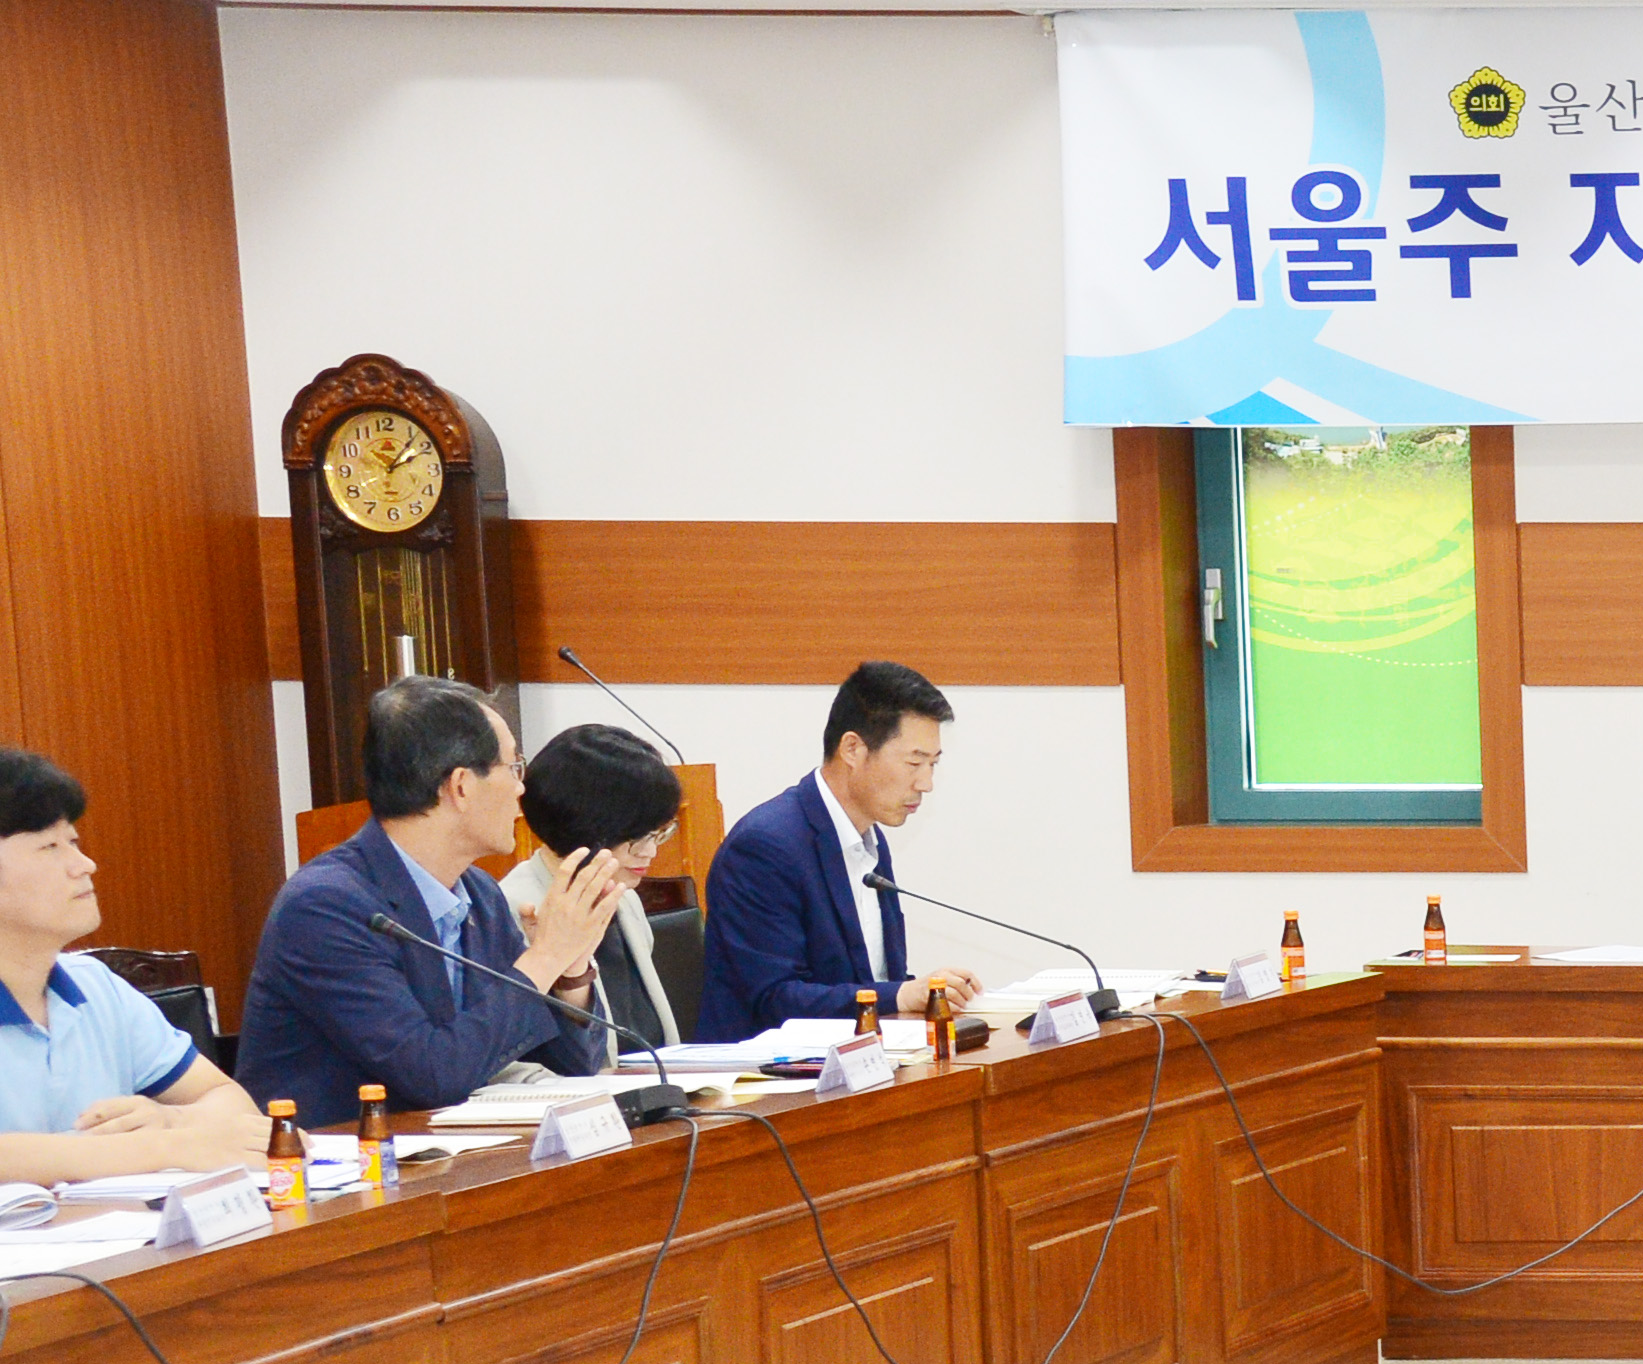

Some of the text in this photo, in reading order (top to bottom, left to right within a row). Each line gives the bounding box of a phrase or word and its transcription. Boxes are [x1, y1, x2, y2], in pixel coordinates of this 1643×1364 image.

[1469, 94, 1504, 112] 의회
[1144, 170, 1518, 303] 서울주
[375, 417, 394, 432] 12
[356, 426, 370, 440] 11
[343, 443, 359, 458] 10
[420, 441, 432, 455] 2
[340, 464, 352, 478] 9
[428, 463, 440, 477] 3
[347, 484, 360, 499] 8
[422, 483, 433, 497] 4
[364, 501, 376, 515] 7
[387, 507, 400, 521] 6
[409, 501, 423, 516] 5
